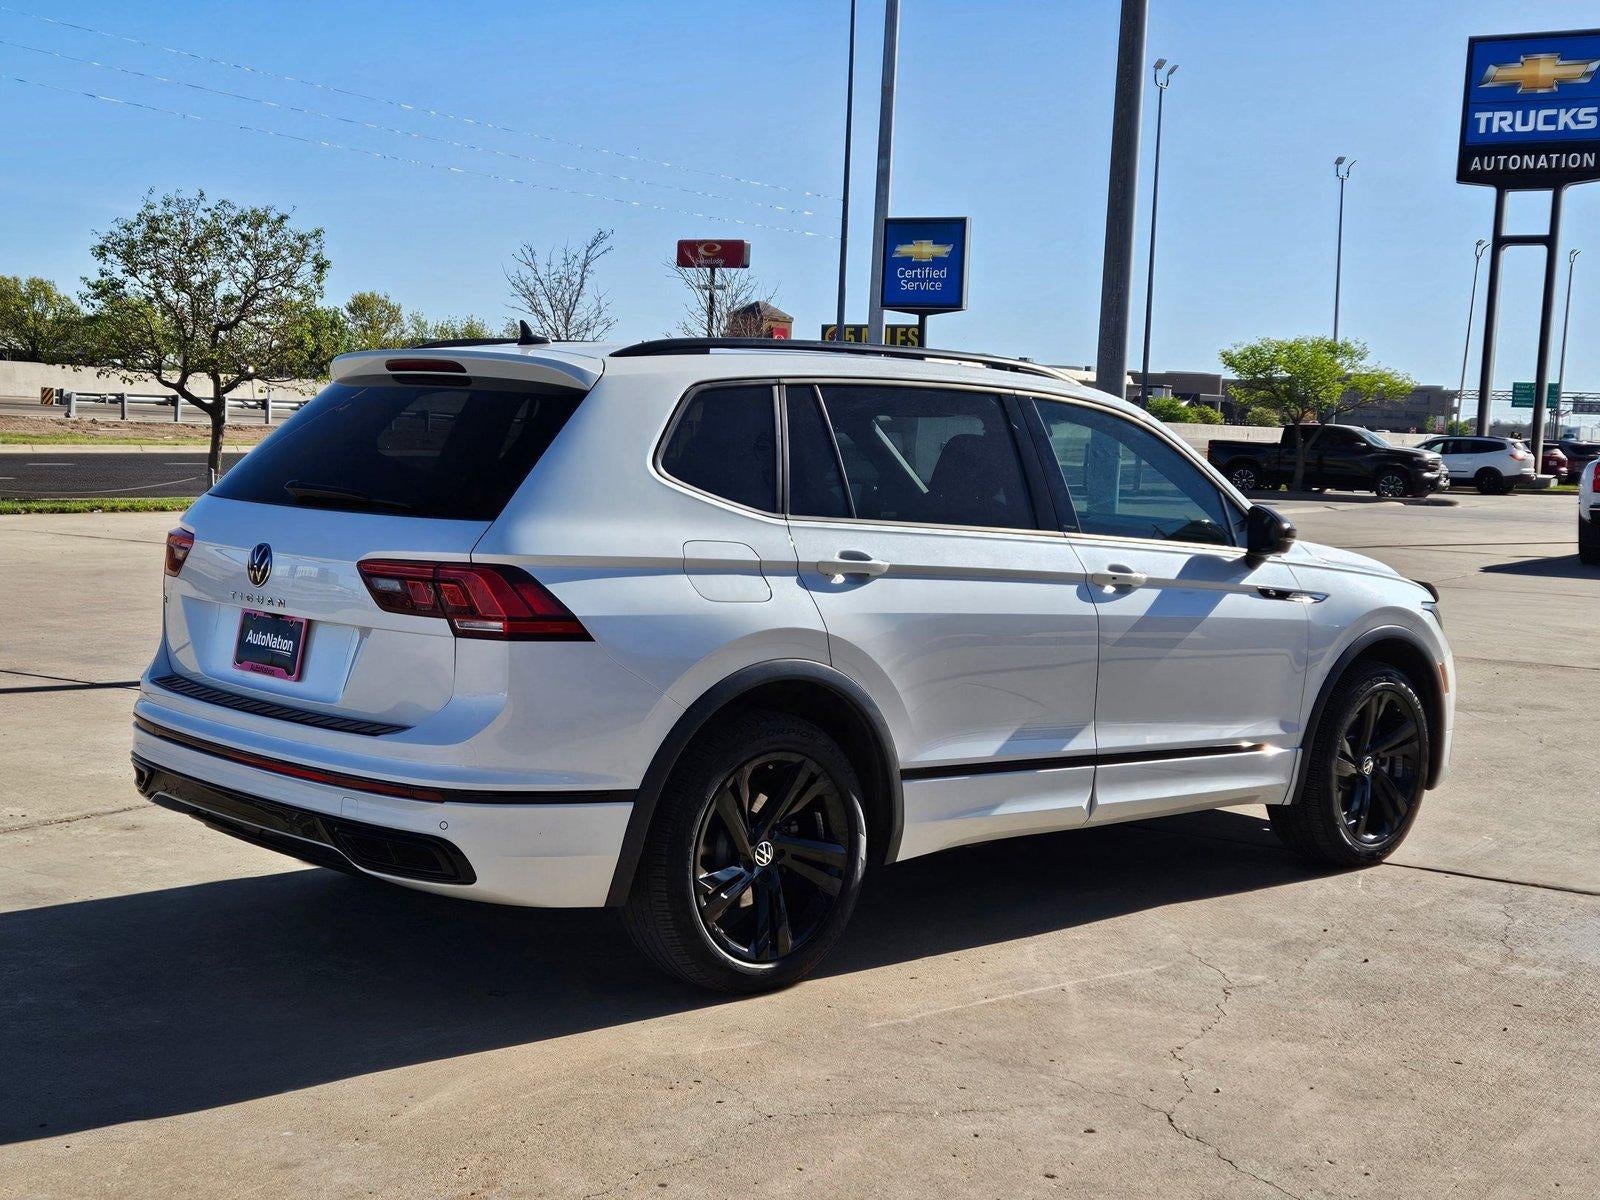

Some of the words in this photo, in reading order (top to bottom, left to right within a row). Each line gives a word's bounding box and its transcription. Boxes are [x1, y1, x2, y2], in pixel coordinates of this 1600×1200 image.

[1474, 106, 1598, 134] TRUCKS
[1470, 153, 1596, 171] AUTONATION
[896, 267, 947, 279] Certified
[900, 279, 943, 291] Service
[230, 591, 287, 608] TIGUAN
[245, 629, 294, 652] AutoNation
